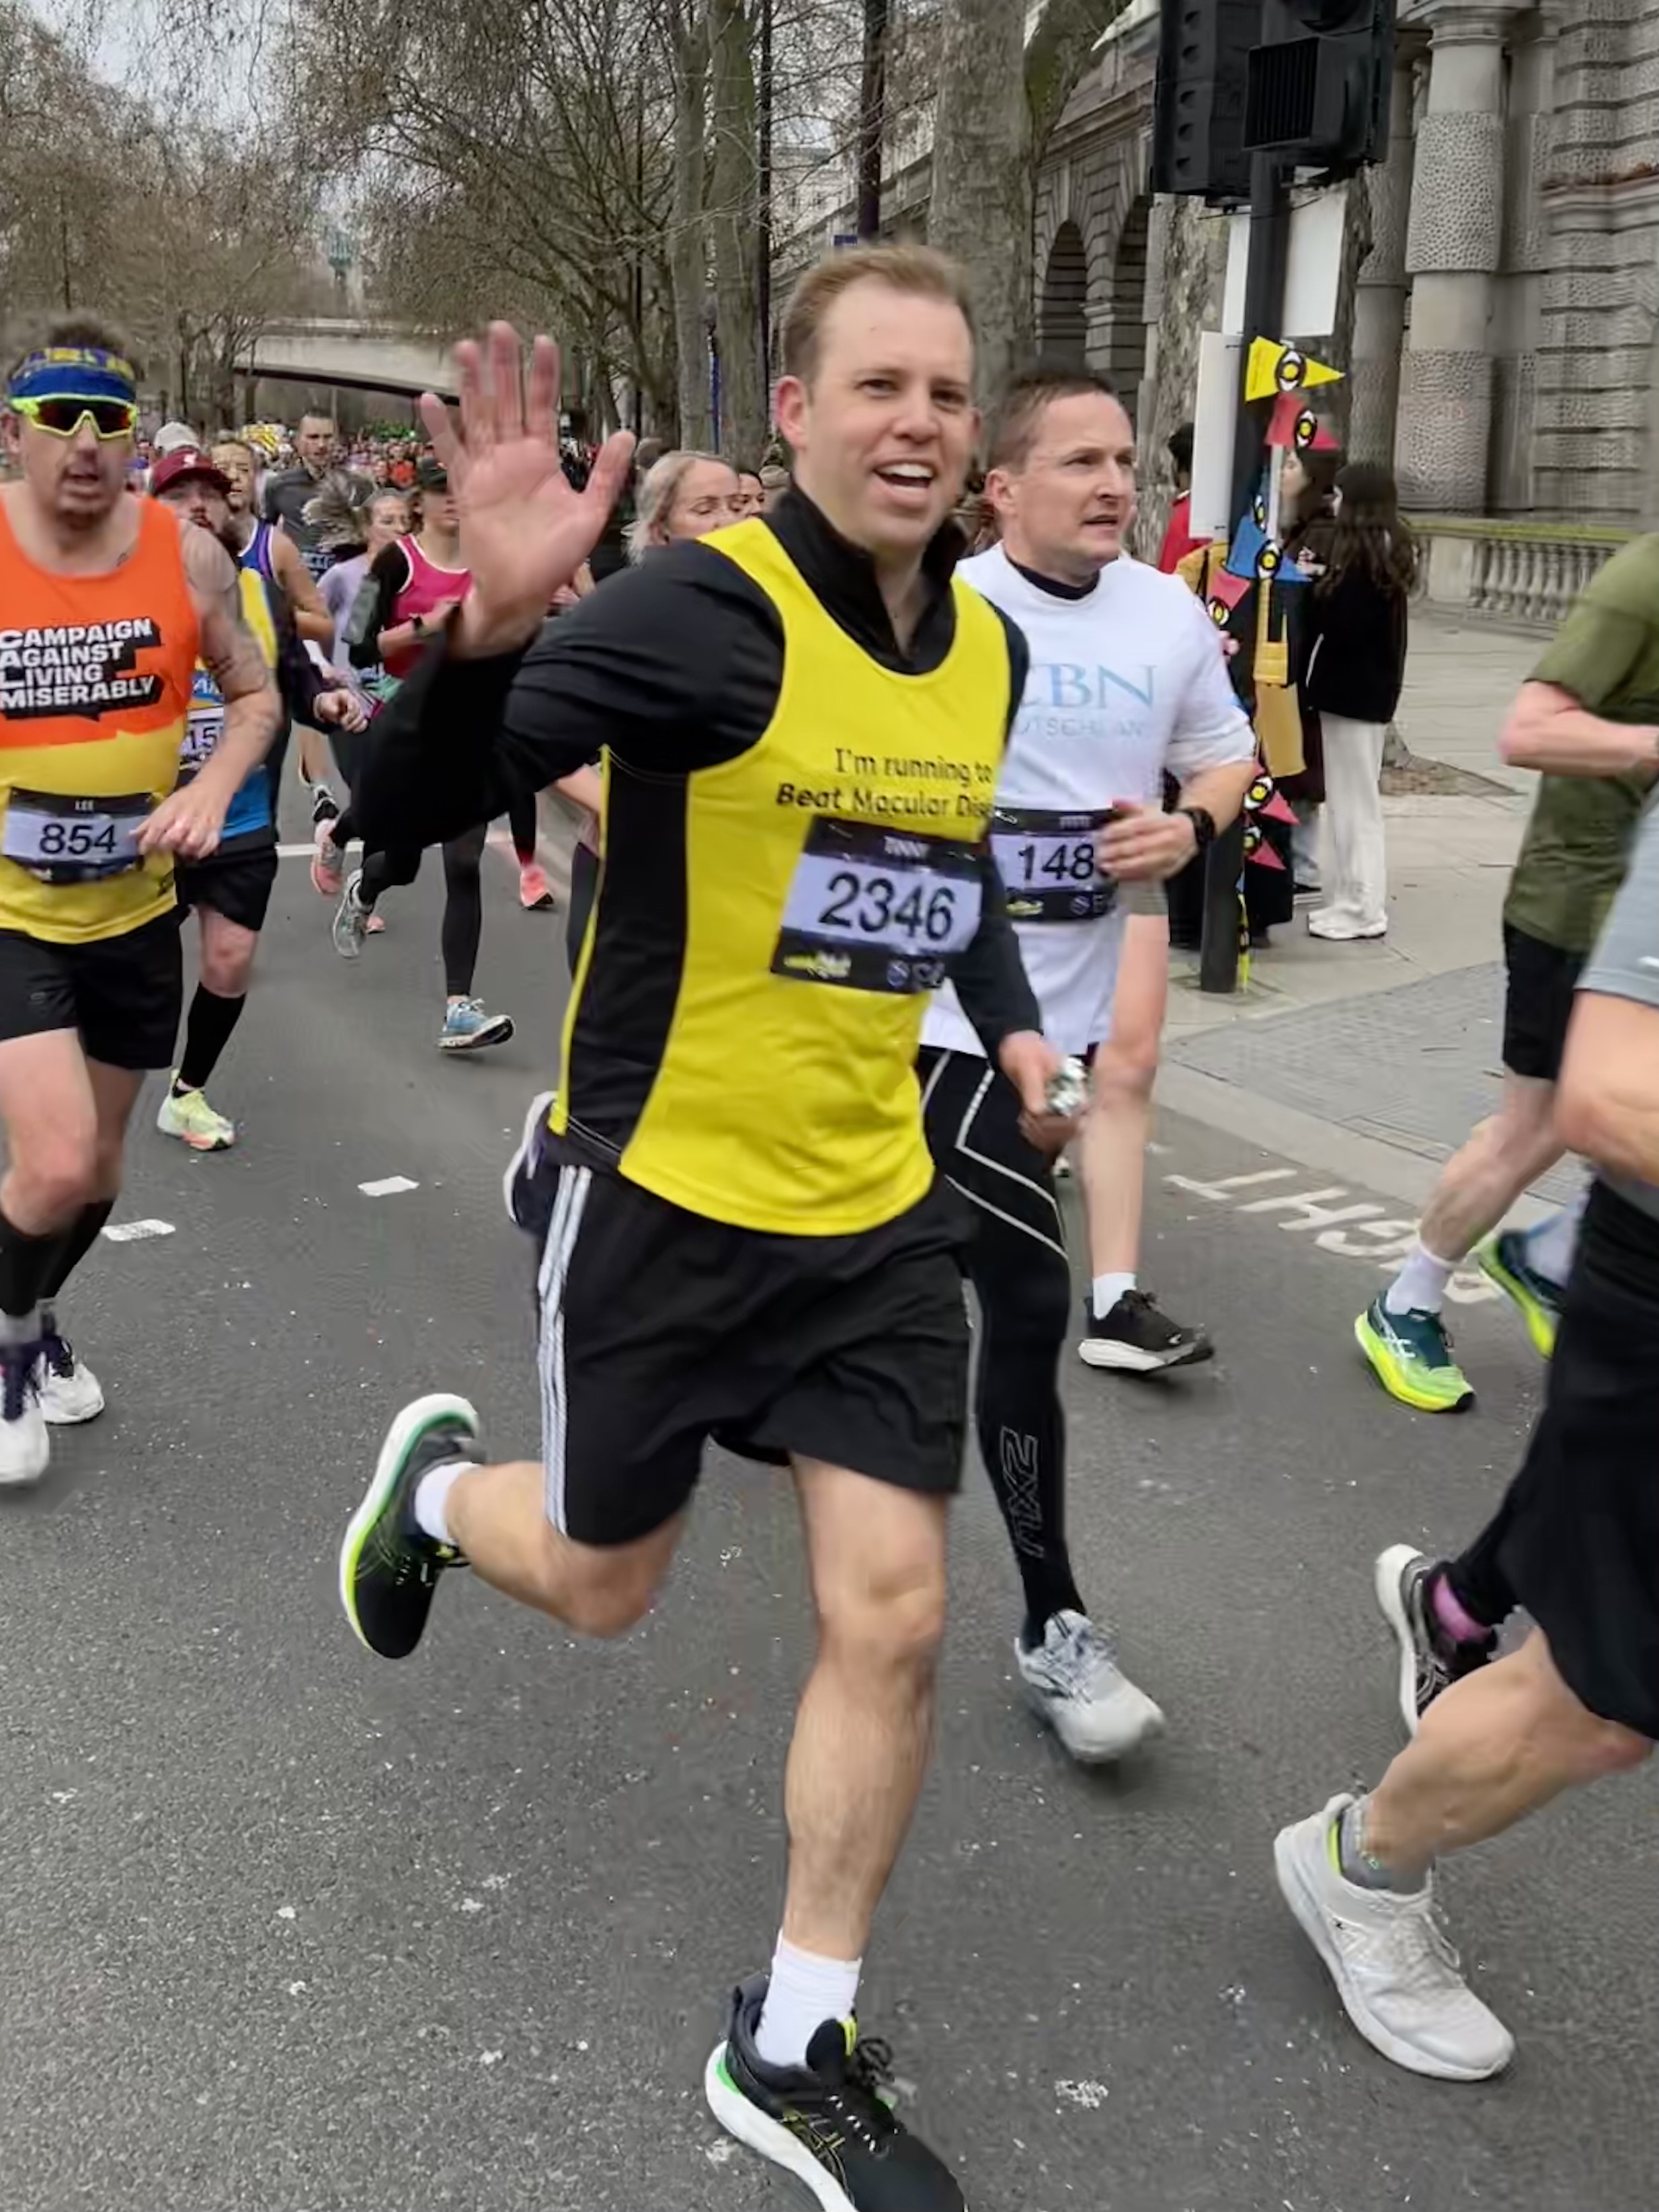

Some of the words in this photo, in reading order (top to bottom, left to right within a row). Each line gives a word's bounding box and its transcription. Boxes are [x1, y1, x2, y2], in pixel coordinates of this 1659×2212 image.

[0, 618, 153, 649] CAMPAIGN
[0, 641, 124, 669] AGAINST
[0, 664, 103, 690] LIVING
[0, 675, 155, 709] MISERABLY
[189, 726, 223, 749] 15
[836, 747, 877, 775] I'm
[883, 755, 971, 787] running
[776, 782, 842, 809] Beat
[852, 787, 949, 817] Macular
[39, 823, 117, 855] 854
[818, 871, 957, 941] 2346
